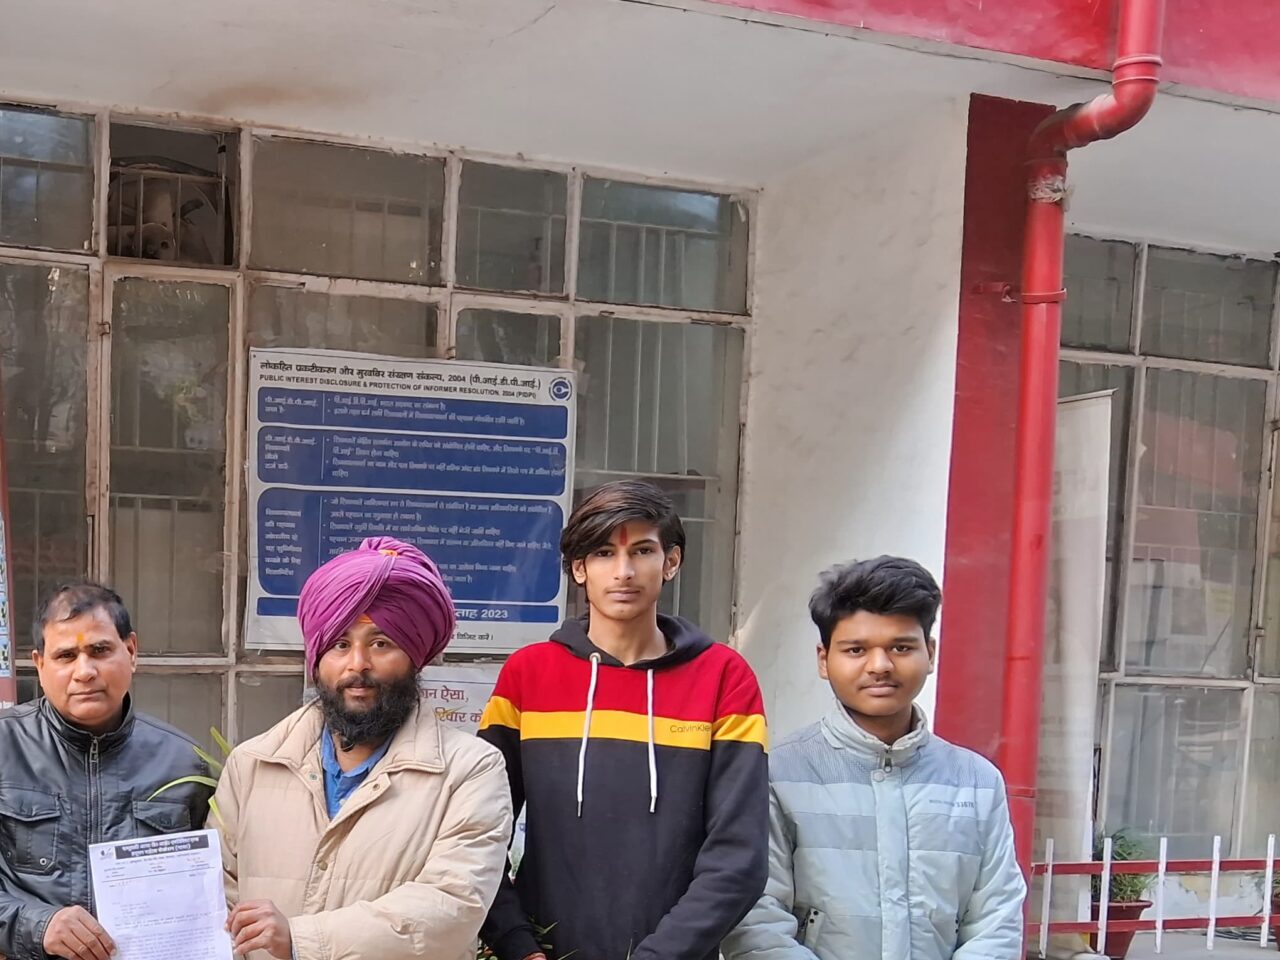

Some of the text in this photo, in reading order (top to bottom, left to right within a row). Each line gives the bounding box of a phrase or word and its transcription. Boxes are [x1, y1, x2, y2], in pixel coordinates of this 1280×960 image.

[260, 361, 293, 371] लोकहित
[339, 366, 354, 376] और
[448, 374, 466, 383] 2004
[260, 374, 284, 382] PUBLIC
[286, 376, 318, 385] INTEREST
[320, 378, 361, 388] DISCLOSURE
[369, 381, 412, 391] PROTECTION
[423, 385, 458, 393] INFORMER
[455, 608, 508, 619] ताह 2023
